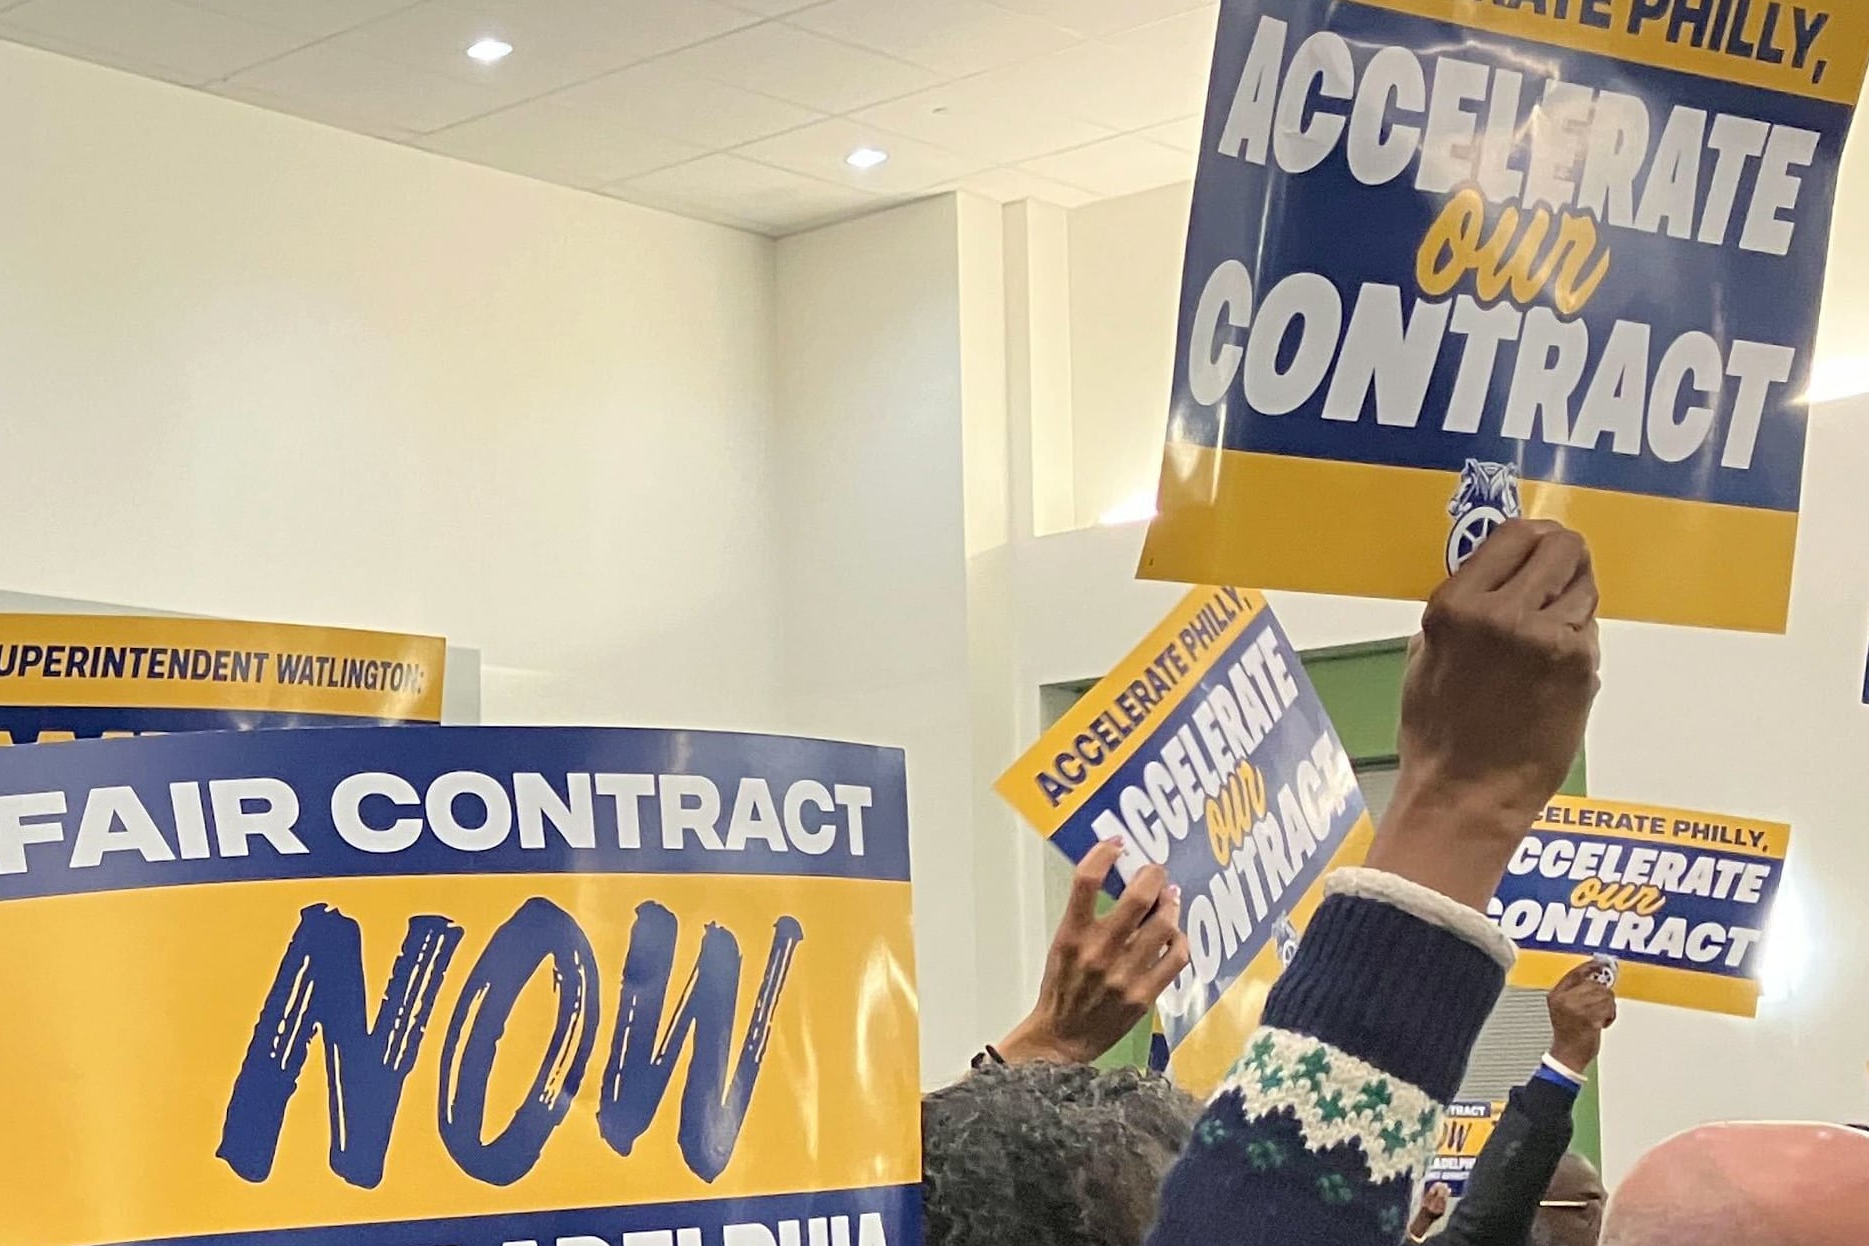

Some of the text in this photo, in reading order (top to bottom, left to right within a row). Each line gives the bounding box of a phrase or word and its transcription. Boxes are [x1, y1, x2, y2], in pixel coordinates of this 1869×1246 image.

[1627, 0, 1829, 84] PHILLY,
[1218, 13, 1821, 257] ACCELERATE
[1415, 188, 1611, 314] our
[1187, 258, 1797, 471] CONTRACT
[276, 653, 425, 695] WATLINGTON:
[1034, 641, 1190, 808] ACCELERATE
[1091, 625, 1298, 879] ACCELERATE
[330, 771, 873, 858] CONTRACT
[1205, 760, 1266, 867] our
[1672, 820, 1769, 852] PHILLY,
[1571, 877, 1667, 915] our
[214, 895, 805, 1190] NOW
